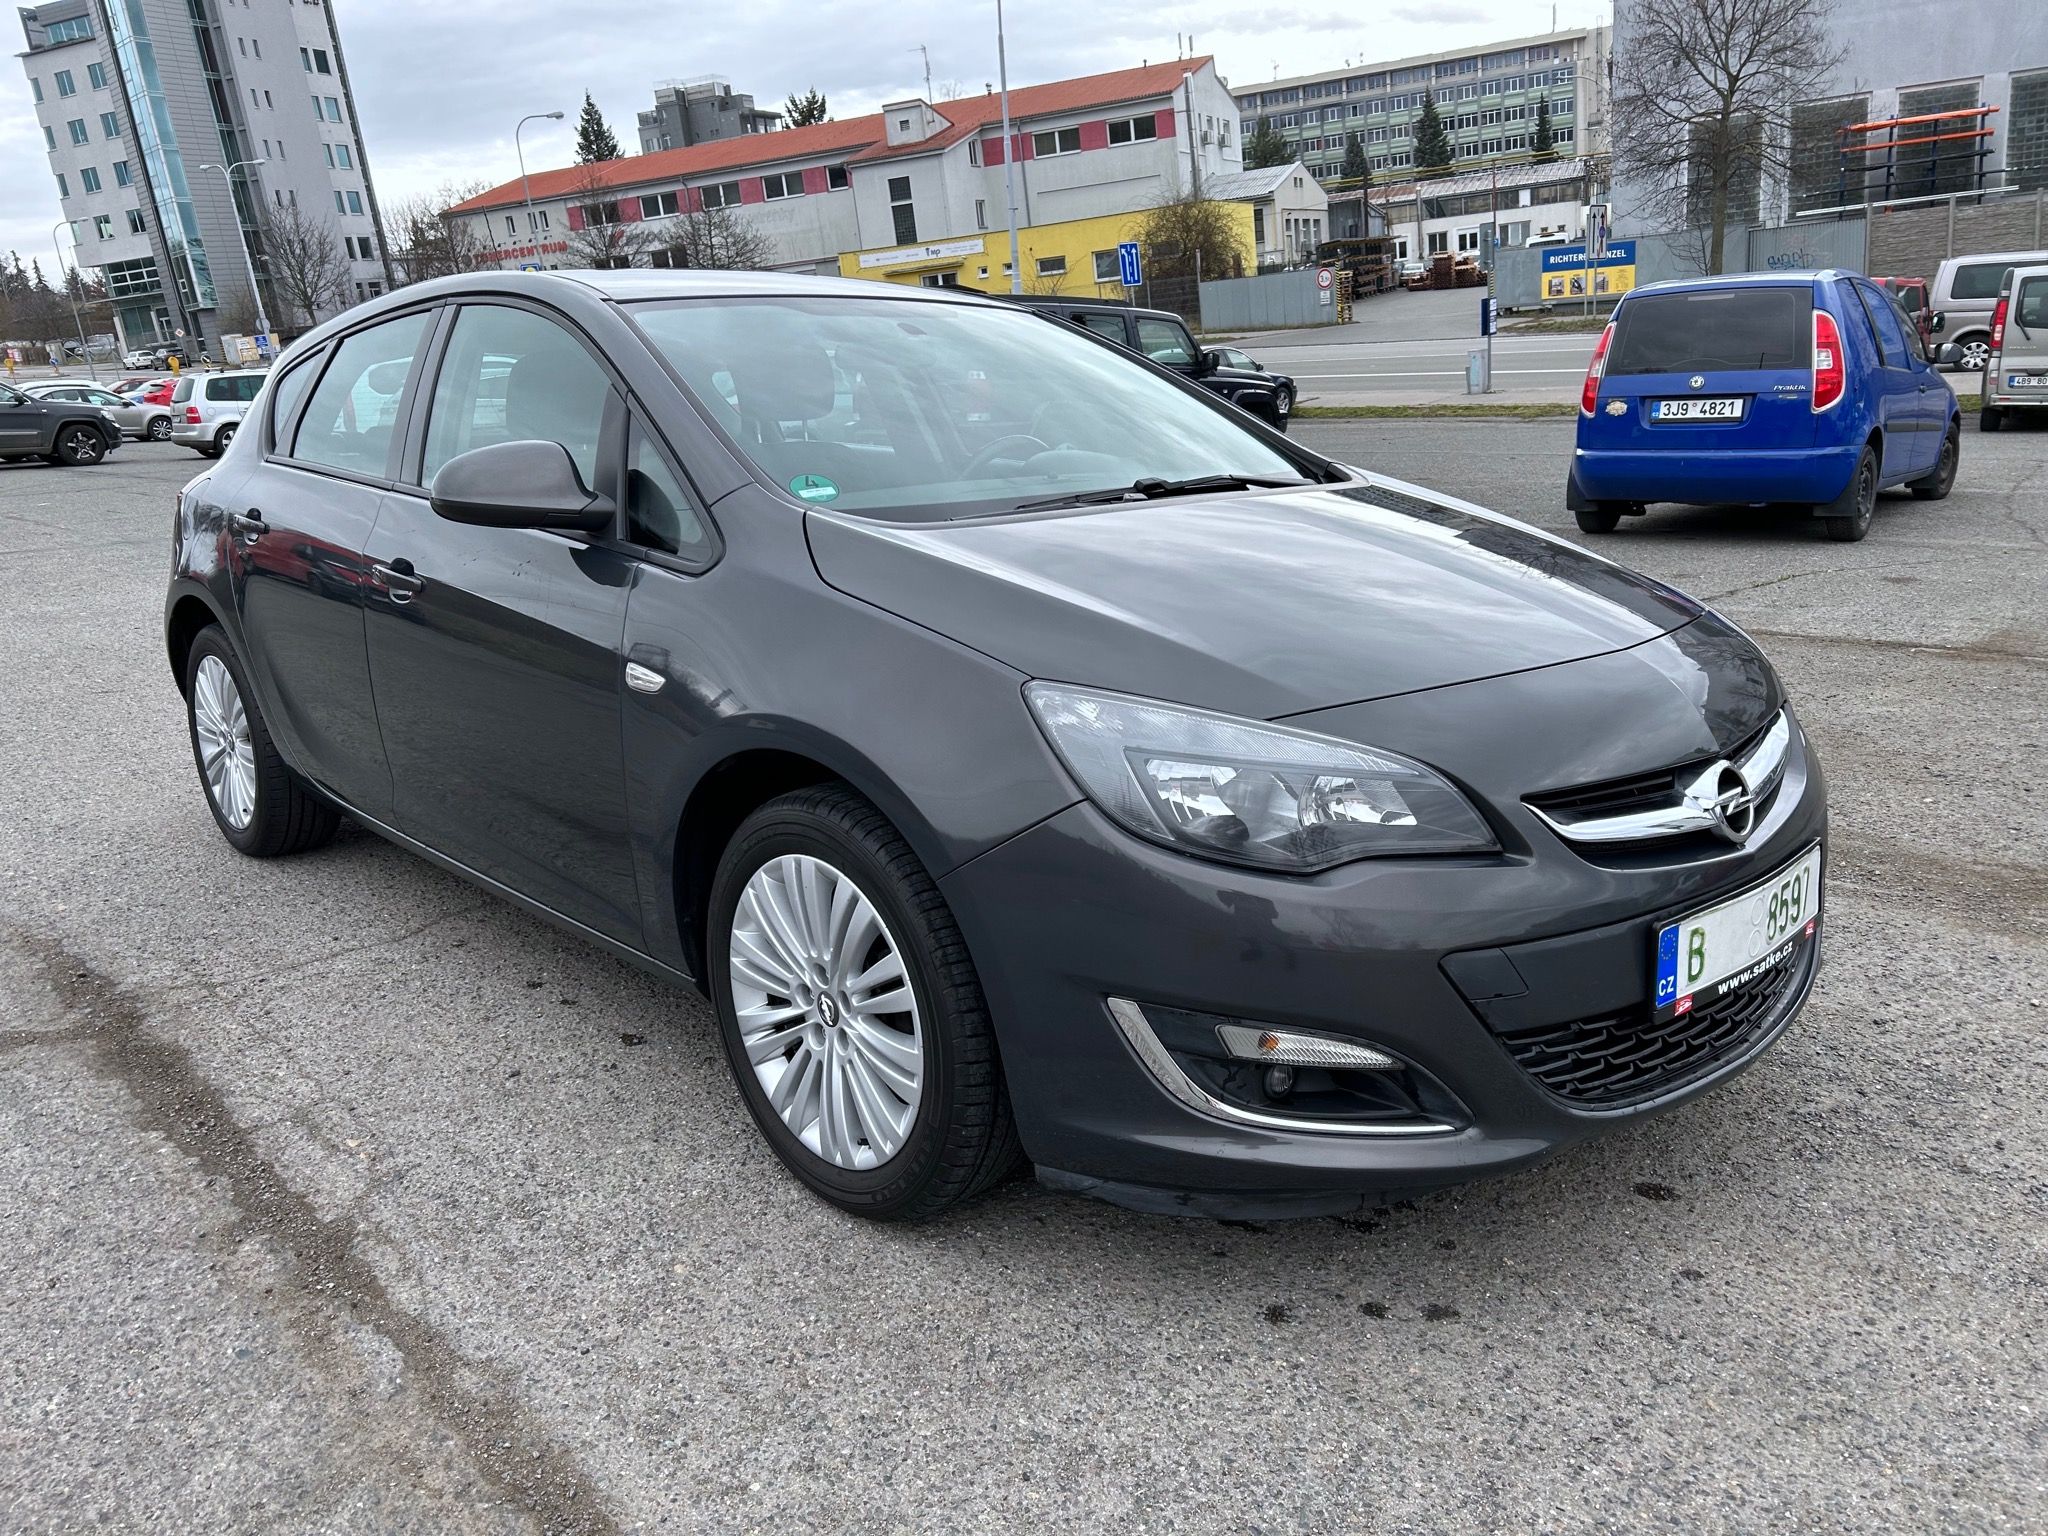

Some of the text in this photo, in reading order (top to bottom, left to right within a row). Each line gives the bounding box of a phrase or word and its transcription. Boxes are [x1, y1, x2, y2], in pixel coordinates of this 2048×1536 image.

[1663, 401, 1735, 416] 3J9 4821
[1687, 865, 1810, 985] B 8597
[1718, 941, 1793, 994] www.satke.cz
[1658, 976, 1675, 996] CZ
